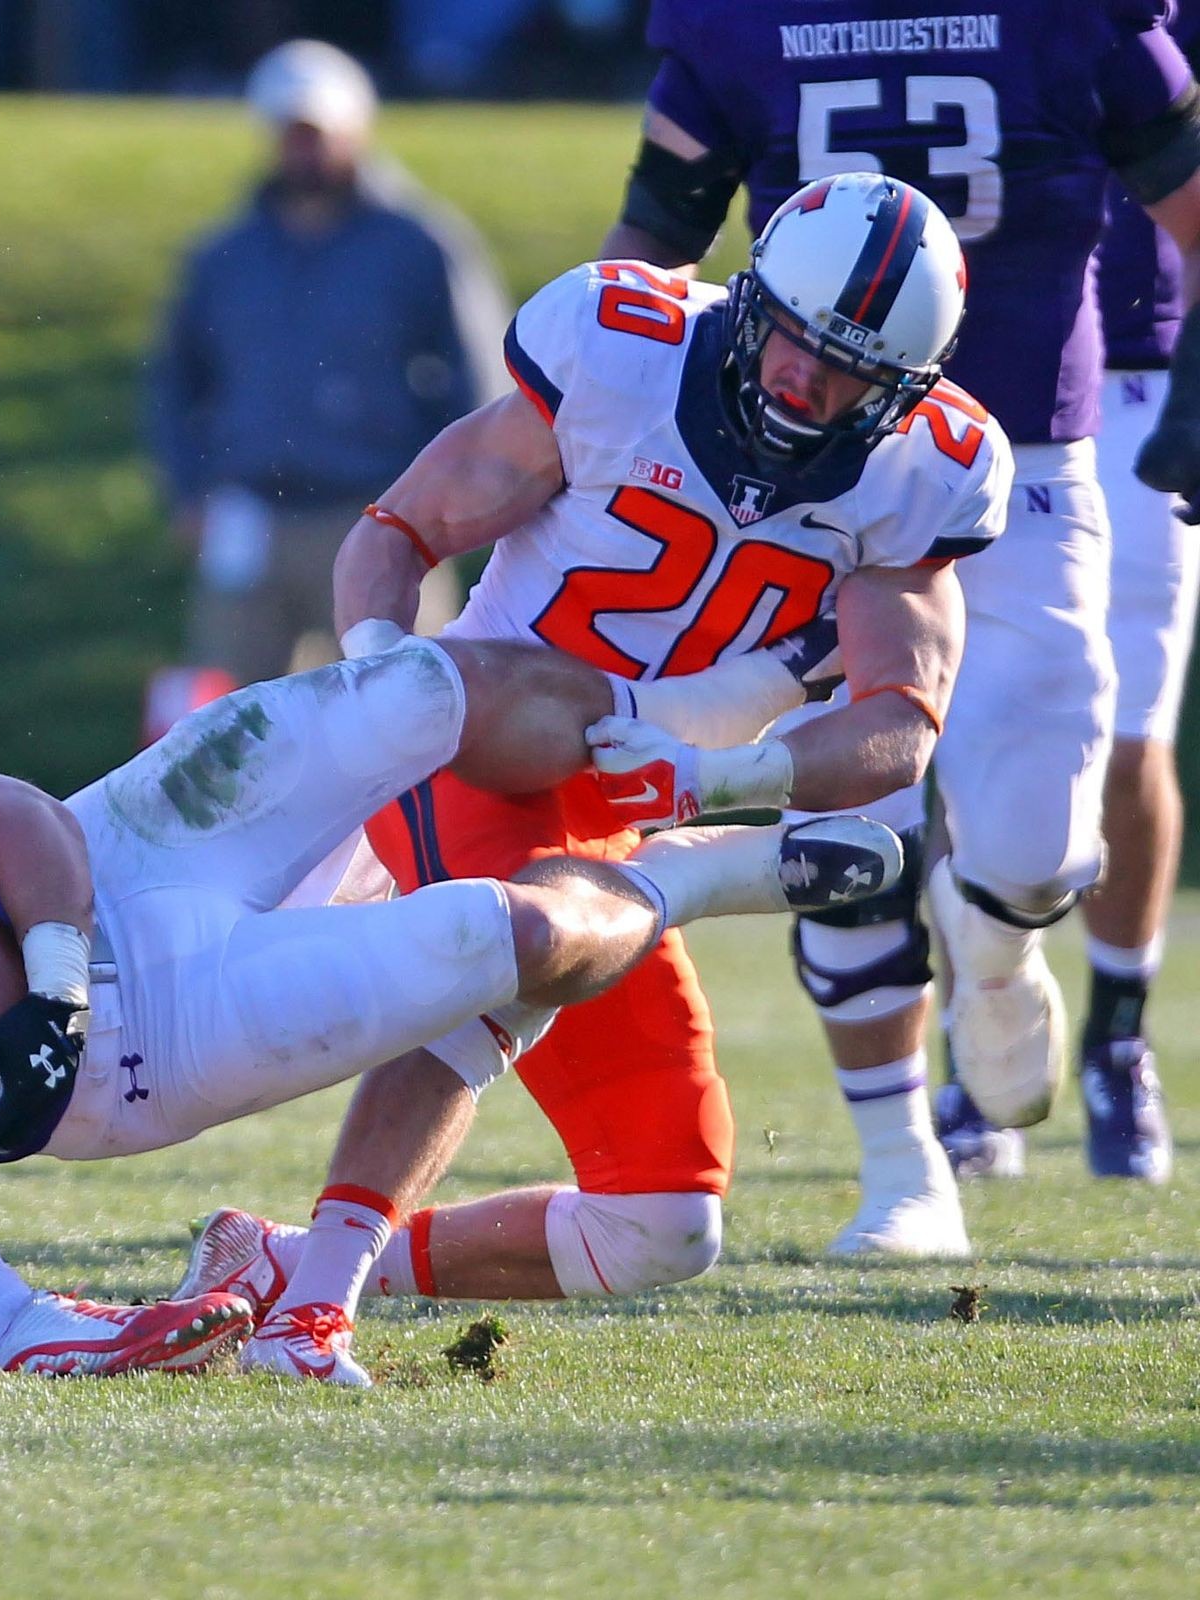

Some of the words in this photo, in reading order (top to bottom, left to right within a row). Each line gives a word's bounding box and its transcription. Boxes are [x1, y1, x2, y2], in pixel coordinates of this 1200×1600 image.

[779, 14, 999, 59] NORTHWESTERN
[798, 75, 1003, 241] 53
[597, 263, 688, 346] 20
[1025, 486, 1052, 514] N
[530, 484, 835, 682] 20
